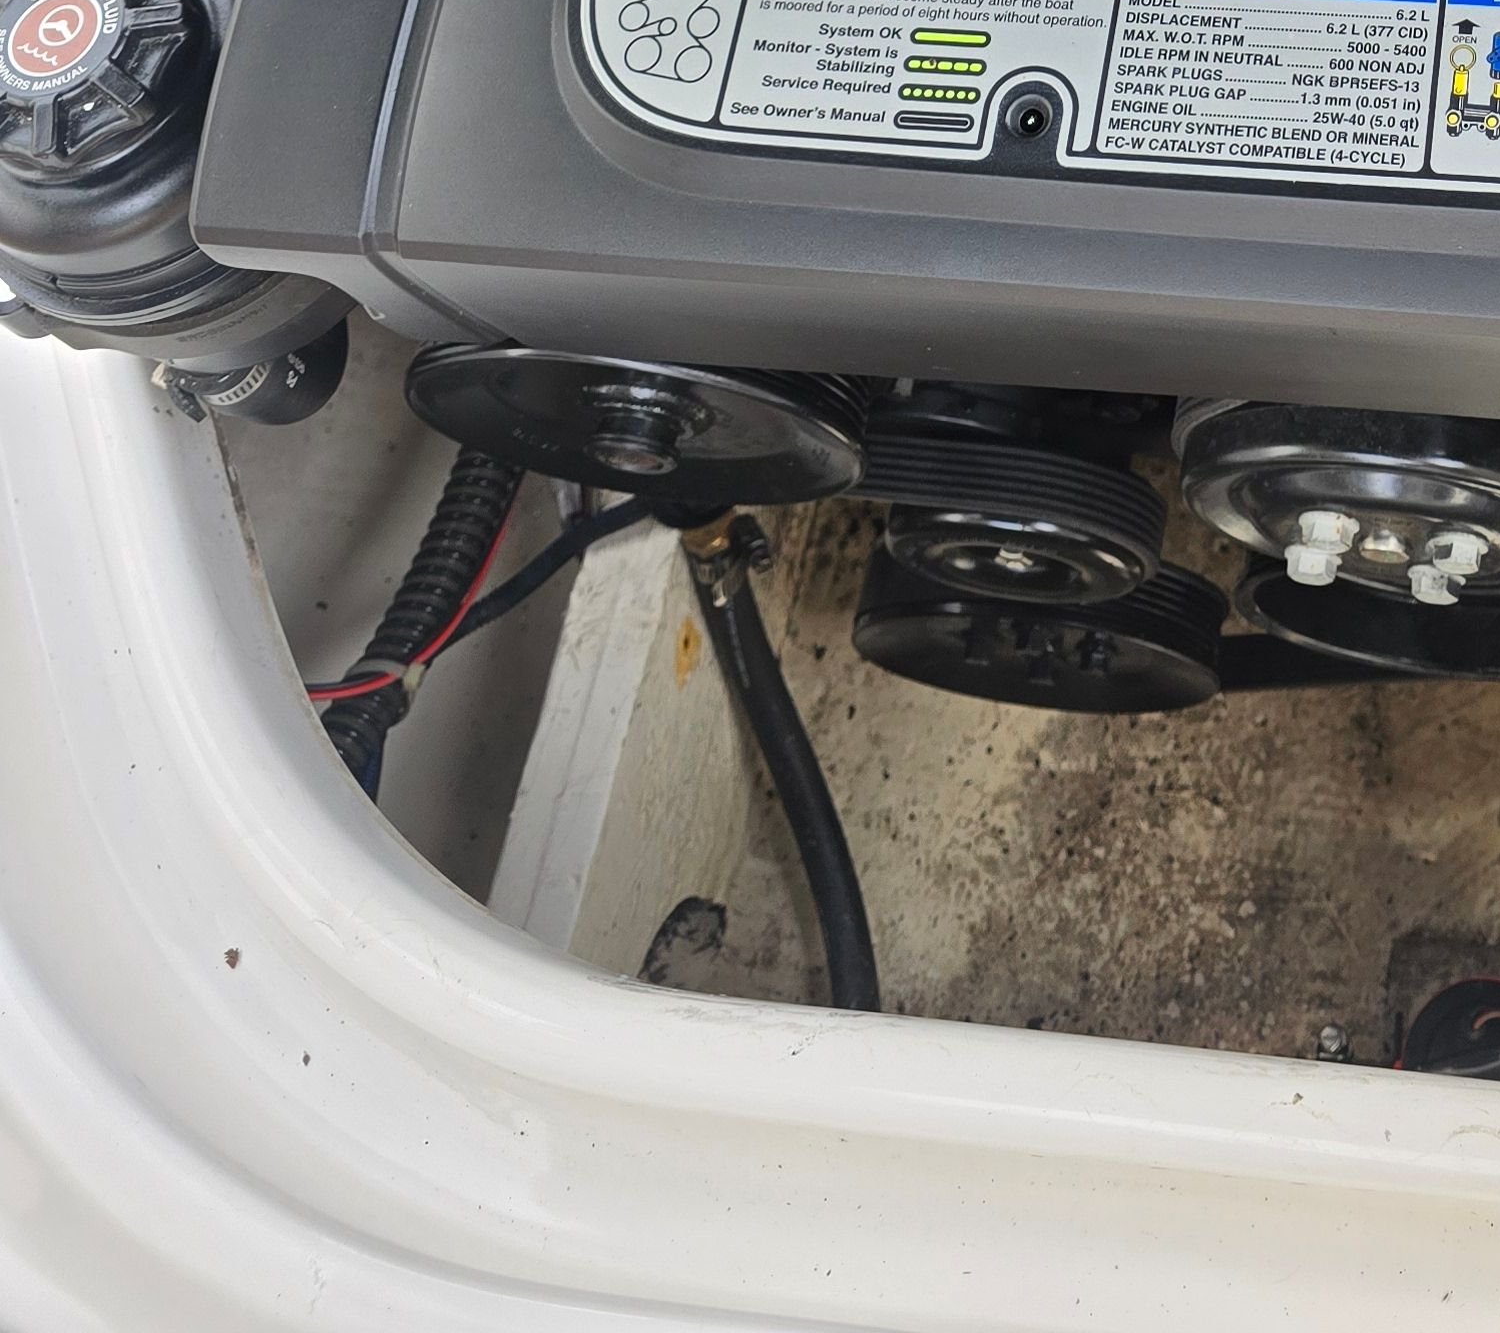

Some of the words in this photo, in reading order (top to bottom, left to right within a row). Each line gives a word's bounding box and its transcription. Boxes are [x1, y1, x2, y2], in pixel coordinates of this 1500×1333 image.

[1125, 11, 1243, 30] DISPLACEMENT
[1395, 8, 1418, 22] 6.2
[1420, 9, 1431, 23] L
[818, 22, 875, 40] System
[878, 26, 904, 41] OK
[1122, 28, 1160, 43] MAX.
[1163, 30, 1208, 46] W.O.T.
[1211, 33, 1245, 48] RPM
[1325, 22, 1348, 36] 6.2
[1350, 23, 1361, 36] L
[1363, 23, 1395, 40] (377
[1397, 25, 1429, 43] CID)
[1451, 34, 1478, 45] OPEN
[752, 38, 813, 54] Monitor
[824, 42, 882, 59] System
[884, 45, 899, 60] is
[1346, 41, 1381, 55] 5000
[1392, 43, 1427, 58] 5400
[31, 65, 89, 92] MANUAL
[815, 58, 896, 79] Stabilizing
[1116, 63, 1169, 79] SPARK
[1170, 66, 1224, 82] PLUGS
[761, 74, 820, 91] Service
[821, 77, 893, 96] Required
[1291, 73, 1326, 88] NGK
[1328, 75, 1420, 94] BPR5EFS-13
[729, 101, 760, 116] See
[762, 103, 827, 120] Owner's
[829, 107, 887, 123] Manual
[1110, 99, 1170, 115] ENGINE
[1171, 102, 1198, 117] OIL
[1312, 110, 1366, 127] 25W-40
[1368, 114, 1397, 131] (5.0
[1399, 116, 1420, 133] qt)
[1104, 135, 1146, 150] FC-W
[1147, 137, 1227, 155] CATALYST
[1228, 142, 1327, 161] COMPATIBLE
[1329, 148, 1406, 169] (4-CYCLE)
